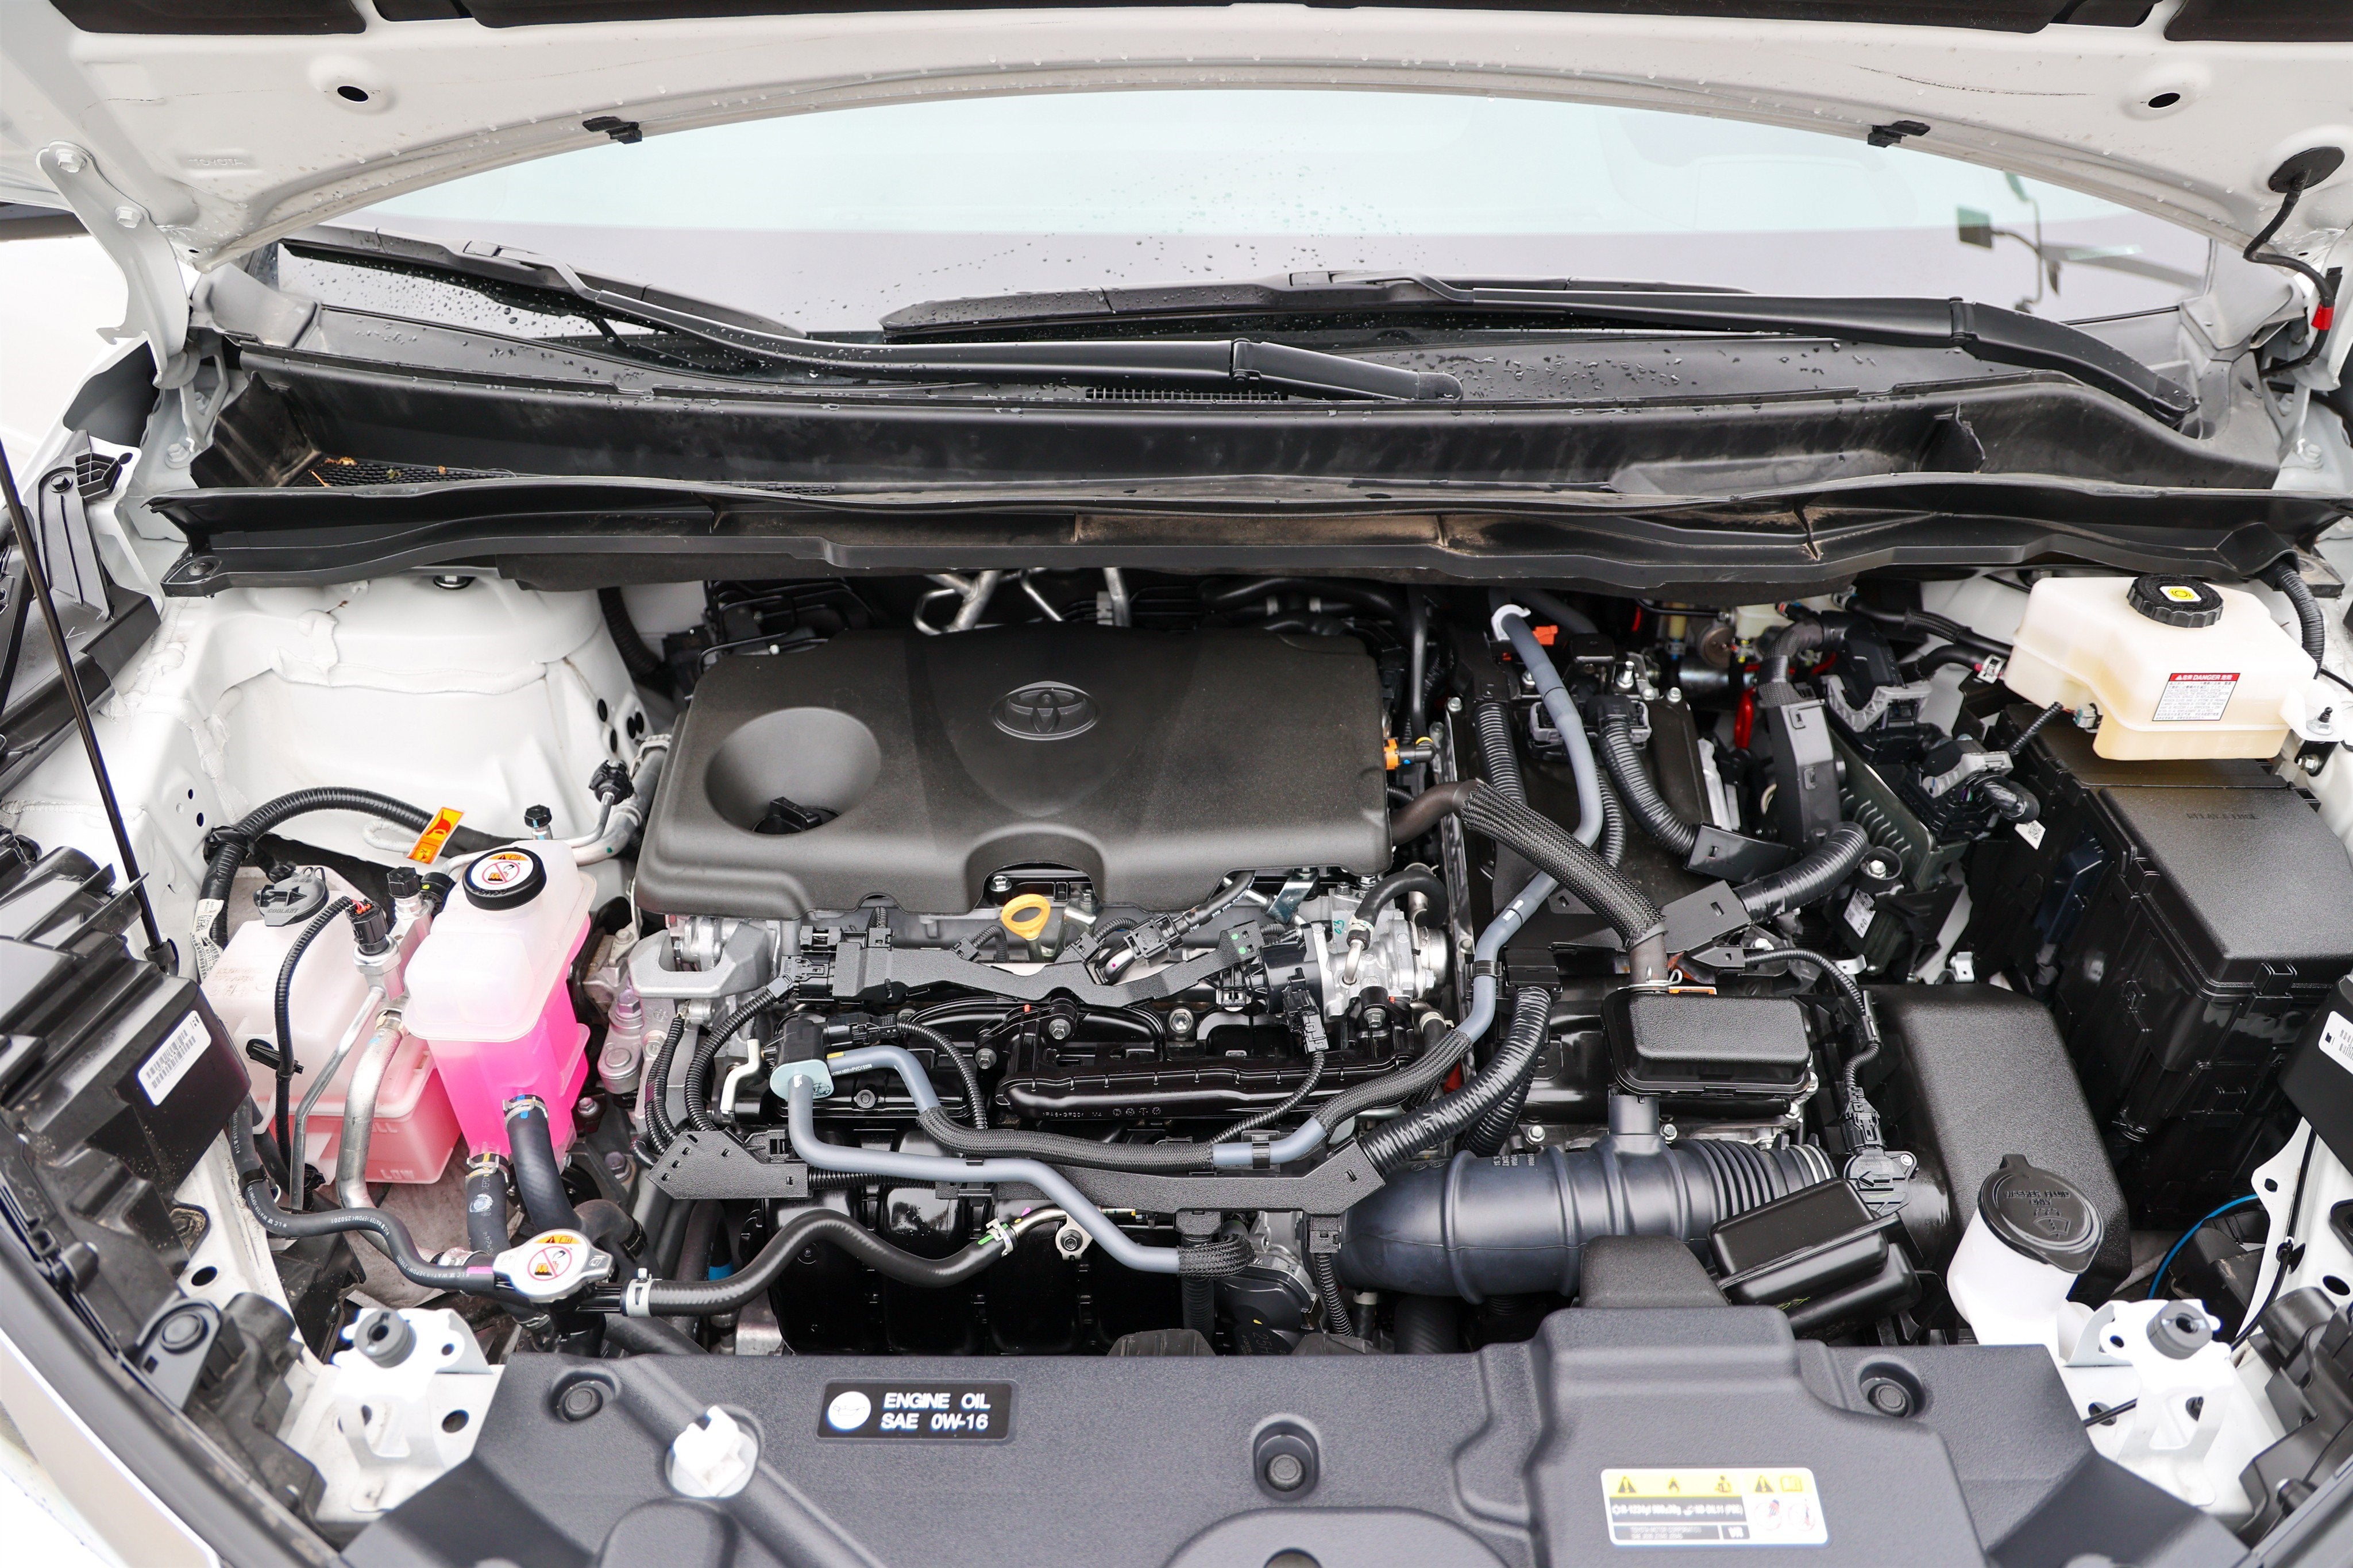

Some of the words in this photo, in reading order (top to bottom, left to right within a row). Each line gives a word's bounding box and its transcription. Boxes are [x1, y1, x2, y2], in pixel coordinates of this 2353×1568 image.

[380, 1169, 415, 1180] LOW
[2004, 1190, 2042, 1199] WASHER
[2045, 1190, 2070, 1199] FLUID
[883, 1393, 951, 1409] ENGINE
[961, 1392, 991, 1410] OIL
[880, 1413, 919, 1430] SAE
[931, 1413, 989, 1430] 0W-16
